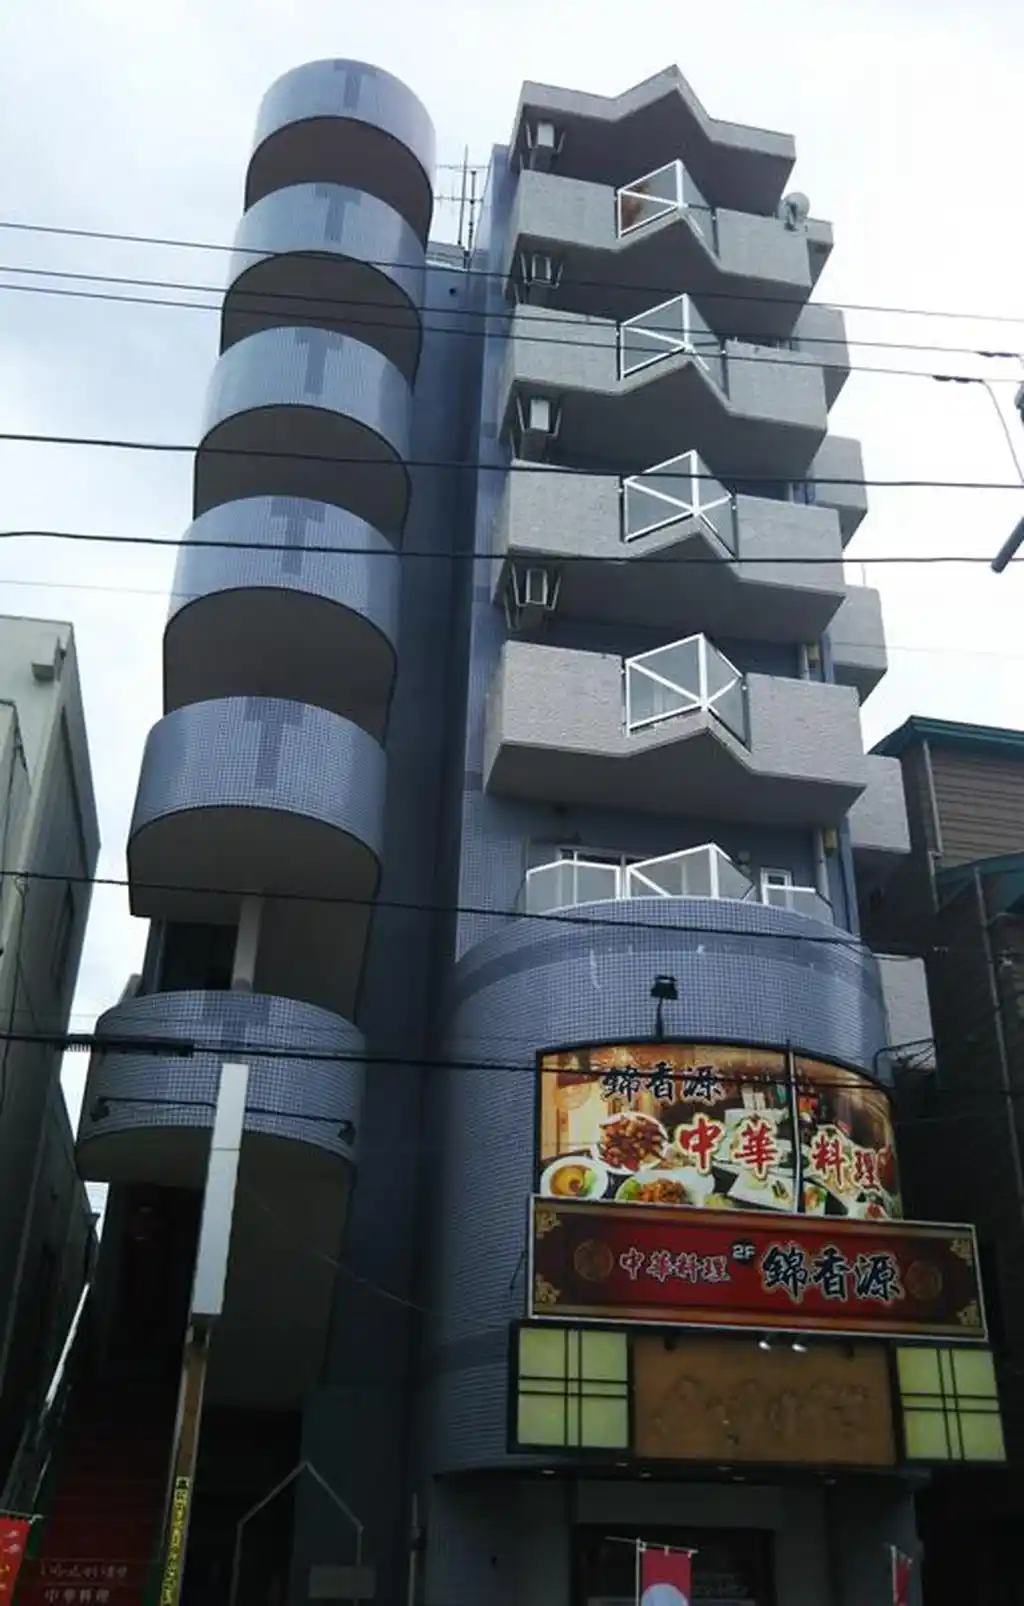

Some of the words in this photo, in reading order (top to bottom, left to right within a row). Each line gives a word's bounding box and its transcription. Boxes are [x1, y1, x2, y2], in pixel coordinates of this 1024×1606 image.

[676, 1113, 880, 1193] 中華料理
[618, 1247, 732, 1284] 中華料理
[732, 1244, 755, 1260] 2F
[761, 1243, 903, 1302] 錦香源
